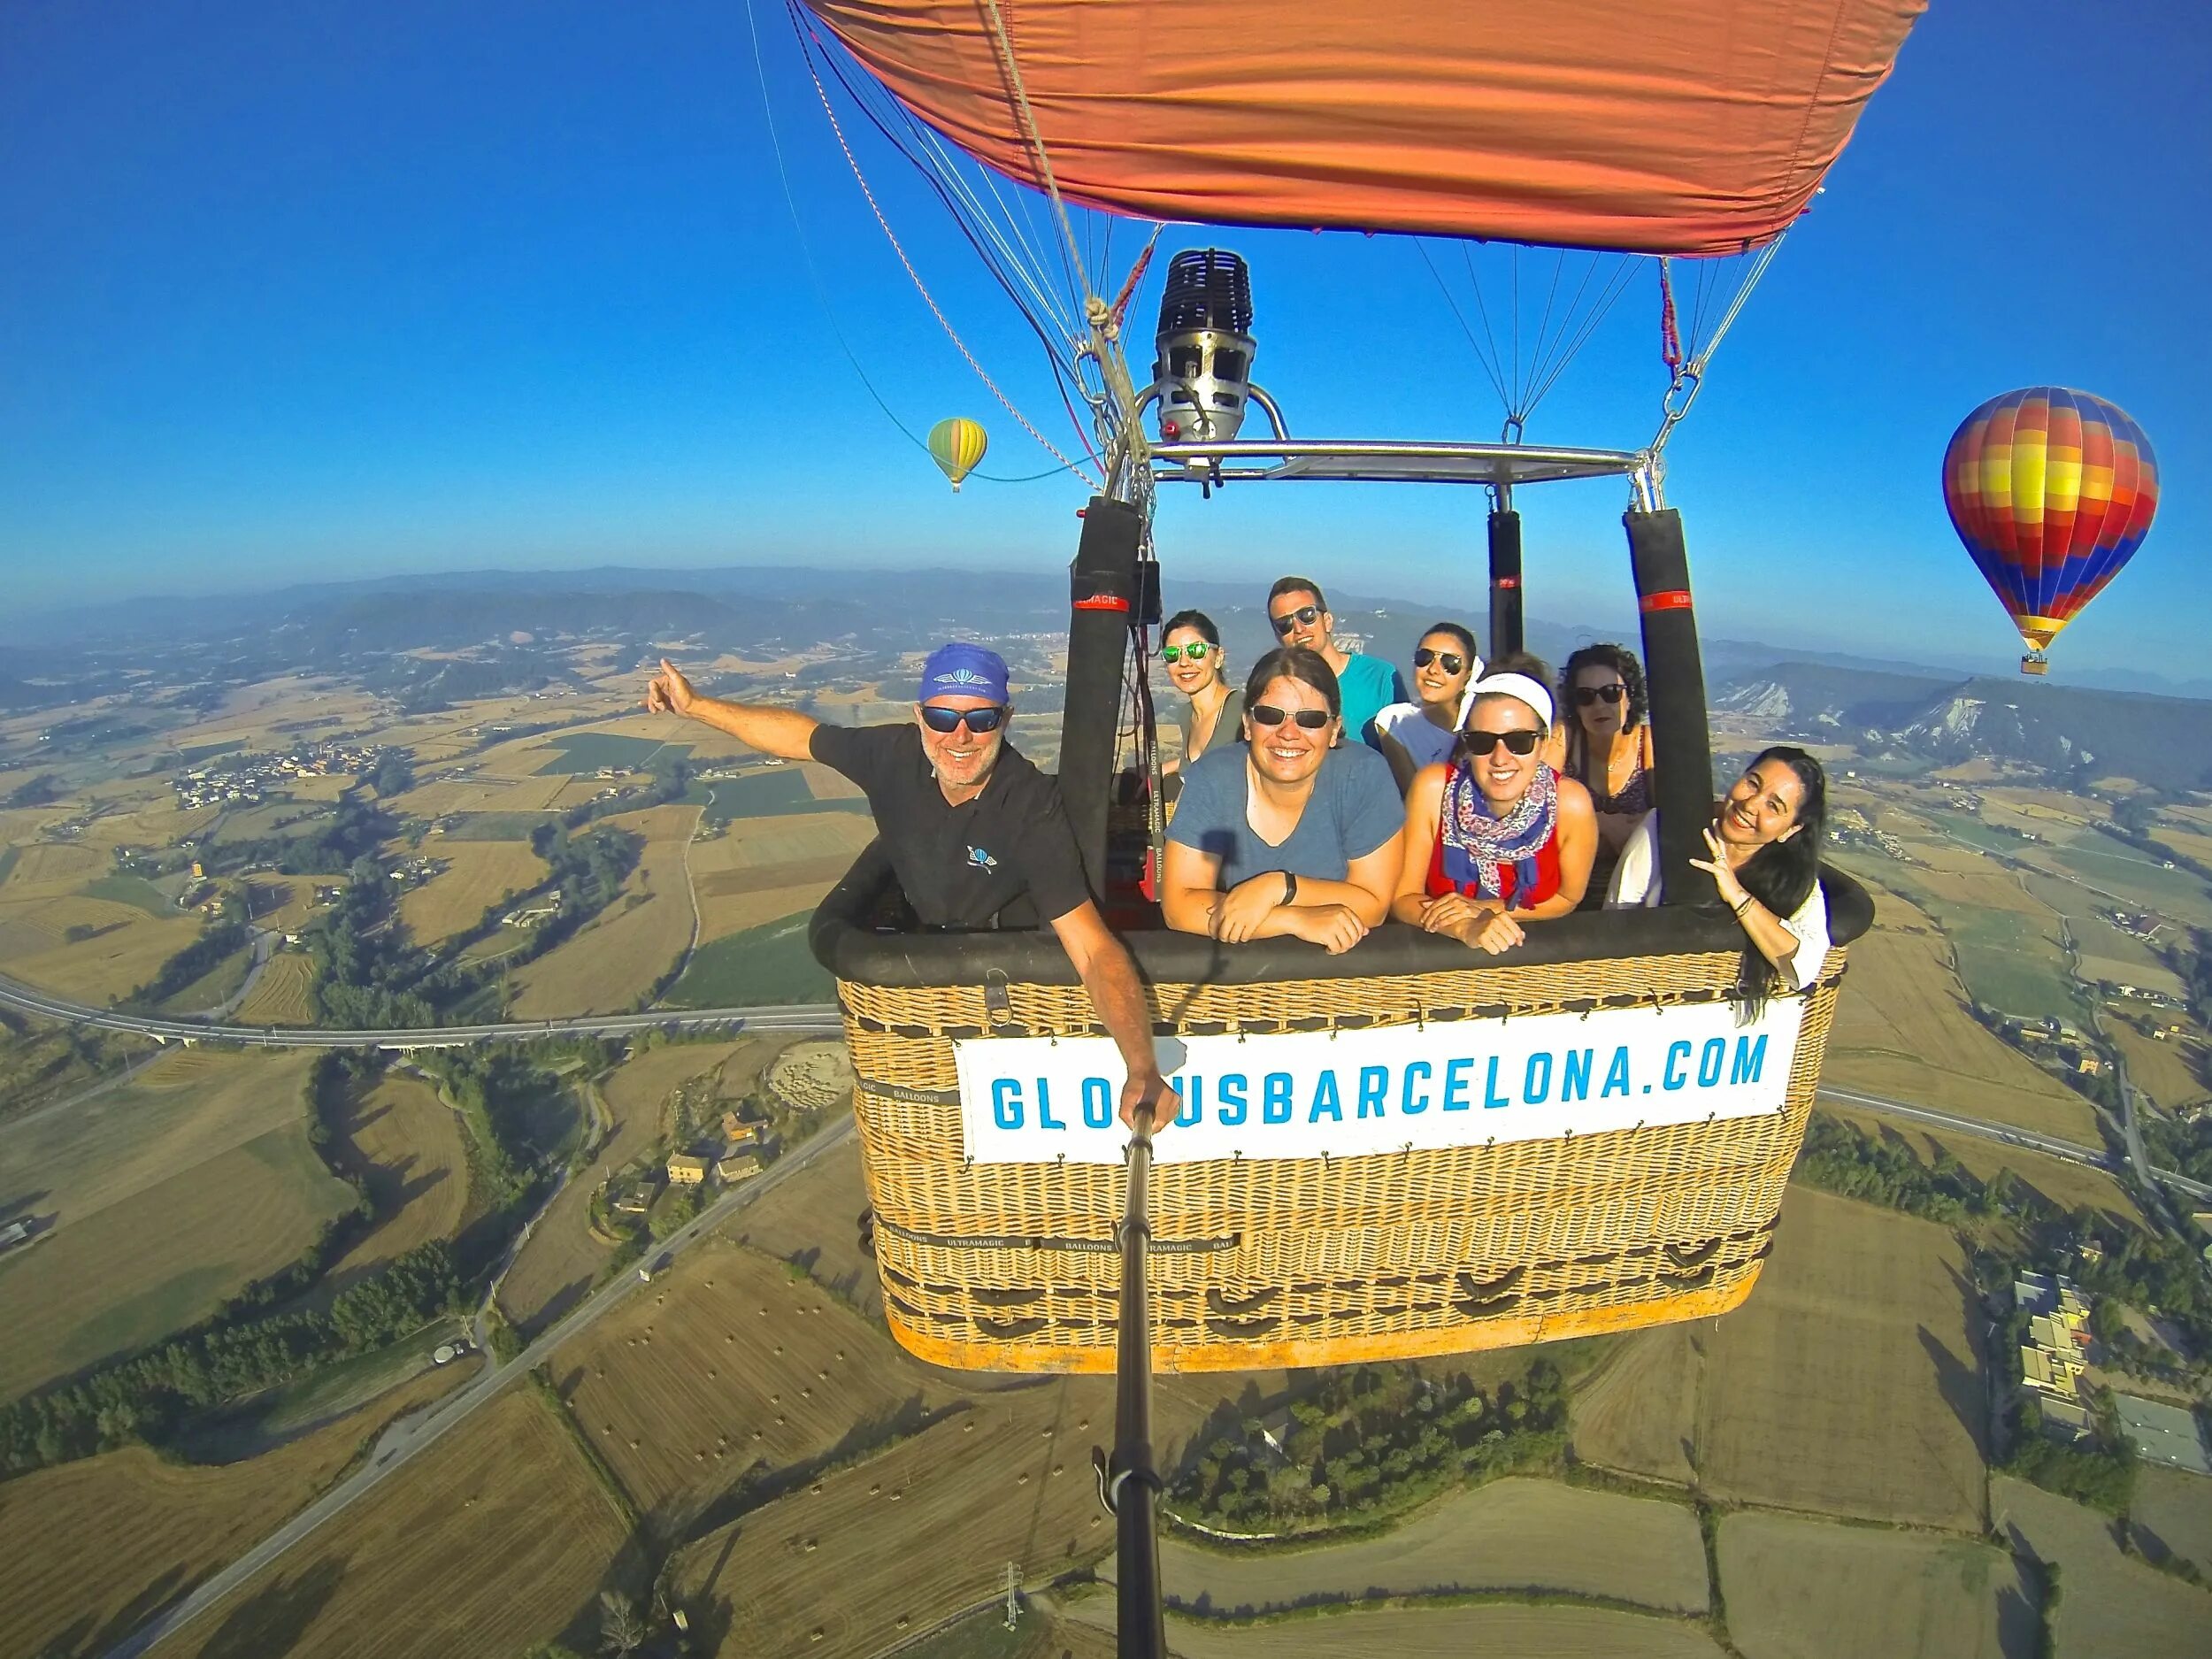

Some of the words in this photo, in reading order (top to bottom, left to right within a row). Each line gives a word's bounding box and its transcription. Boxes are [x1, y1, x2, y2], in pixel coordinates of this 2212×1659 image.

[1075, 595, 1118, 605] MAGIC
[991, 1034, 1769, 1130] GLOUSBARCELONA.COM
[894, 1090, 940, 1103] BALLOONS
[888, 1225, 927, 1243] BALLOONS
[1065, 1242, 1112, 1251] BALLOONS
